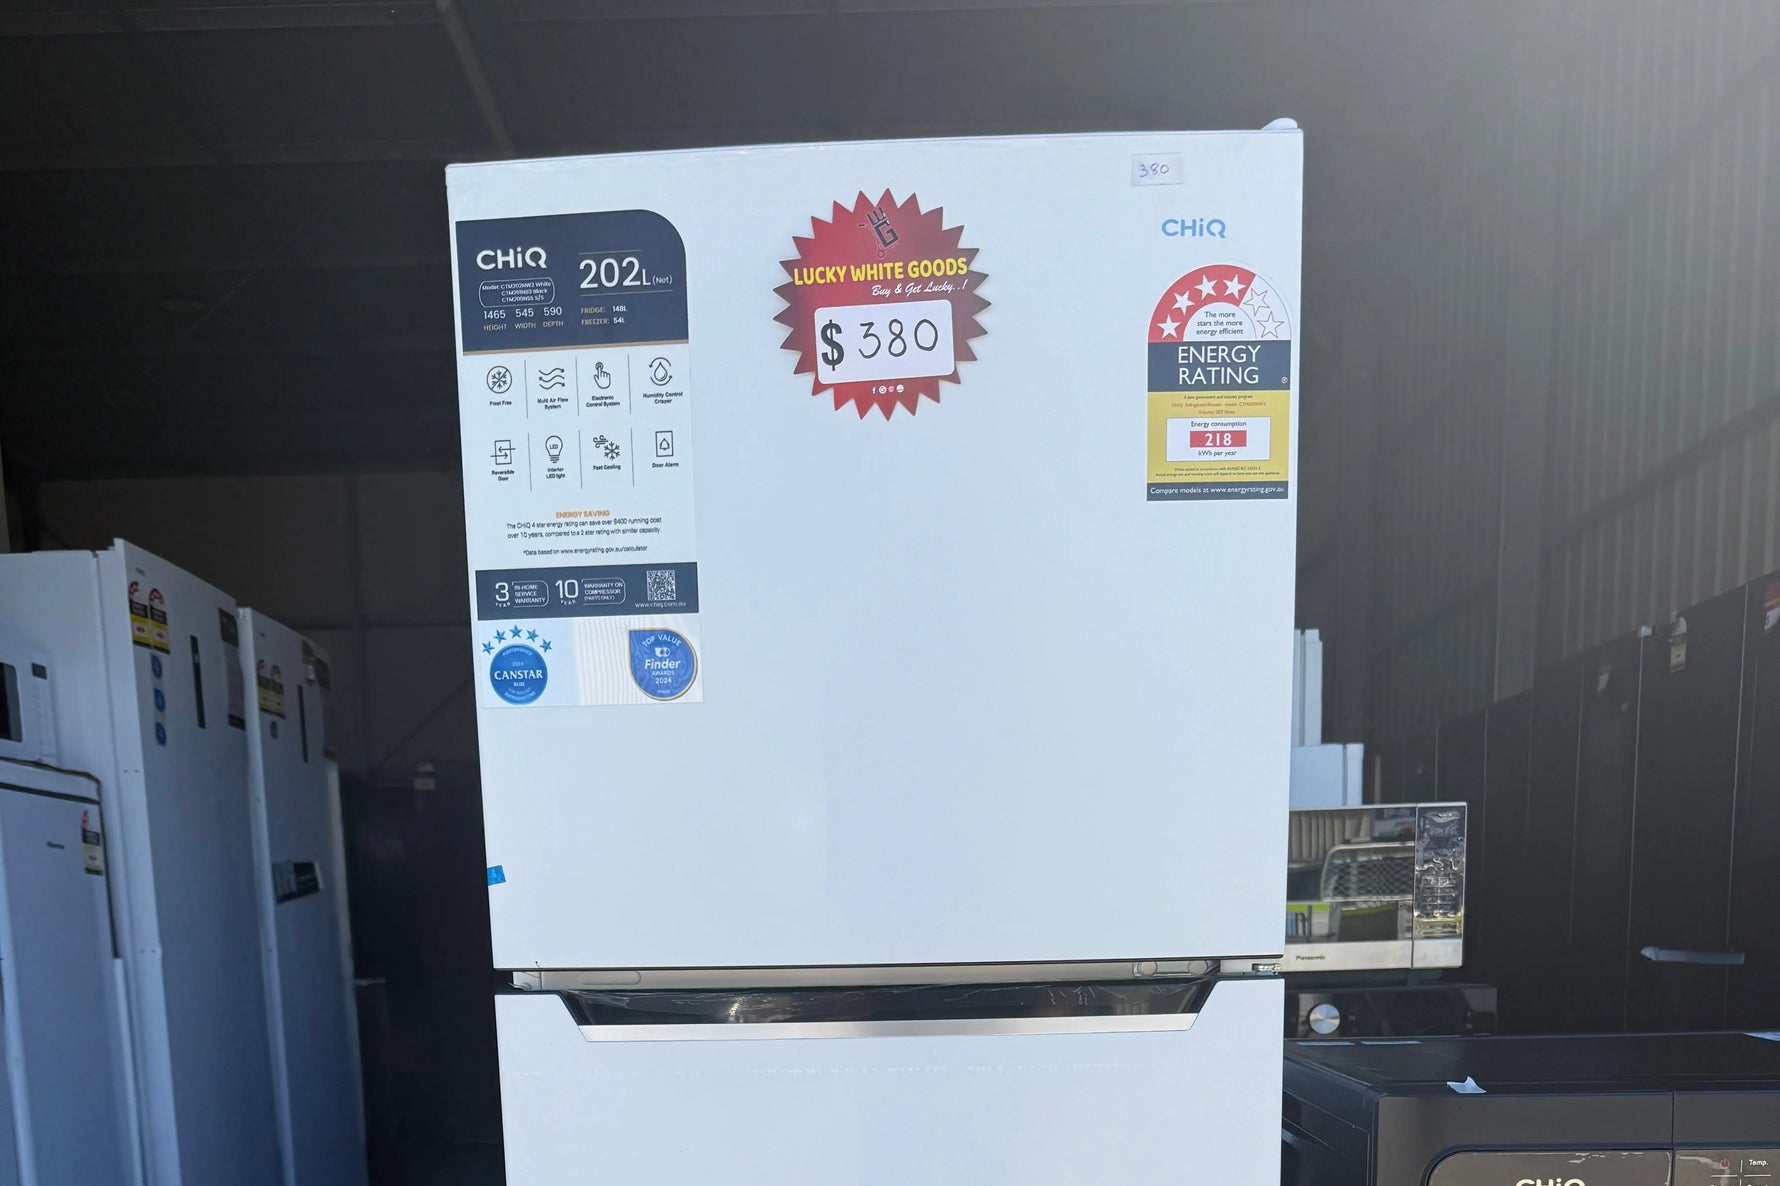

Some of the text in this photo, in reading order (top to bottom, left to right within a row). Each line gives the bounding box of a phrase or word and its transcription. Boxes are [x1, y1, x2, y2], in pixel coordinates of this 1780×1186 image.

[1139, 163, 1169, 178] 380
[1162, 218, 1226, 238] CHiQ
[476, 247, 547, 271] CHiQ
[794, 258, 968, 286] LUCKY WHITE GOODS
[872, 286, 890, 297] Buy
[895, 285, 902, 294] &
[906, 282, 921, 296] Get
[484, 310, 506, 320] 1465
[516, 308, 534, 318] 545
[544, 307, 562, 316] 590
[581, 306, 606, 315] FRIDGE:
[581, 318, 610, 326] FREEZER:
[820, 318, 938, 371] $ 380
[1178, 346, 1261, 363] ENERGY
[1179, 367, 1259, 385] RATING
[1191, 421, 1210, 429] Energy
[1205, 433, 1232, 446] 218
[556, 510, 610, 519] ENERGY SAVING
[545, 530, 570, 538] compared
[495, 583, 509, 602] 3
[555, 579, 579, 599] 10
[642, 634, 682, 647] TOP VALUE
[644, 658, 681, 670] Finder
[494, 670, 543, 680] CANSTAR
